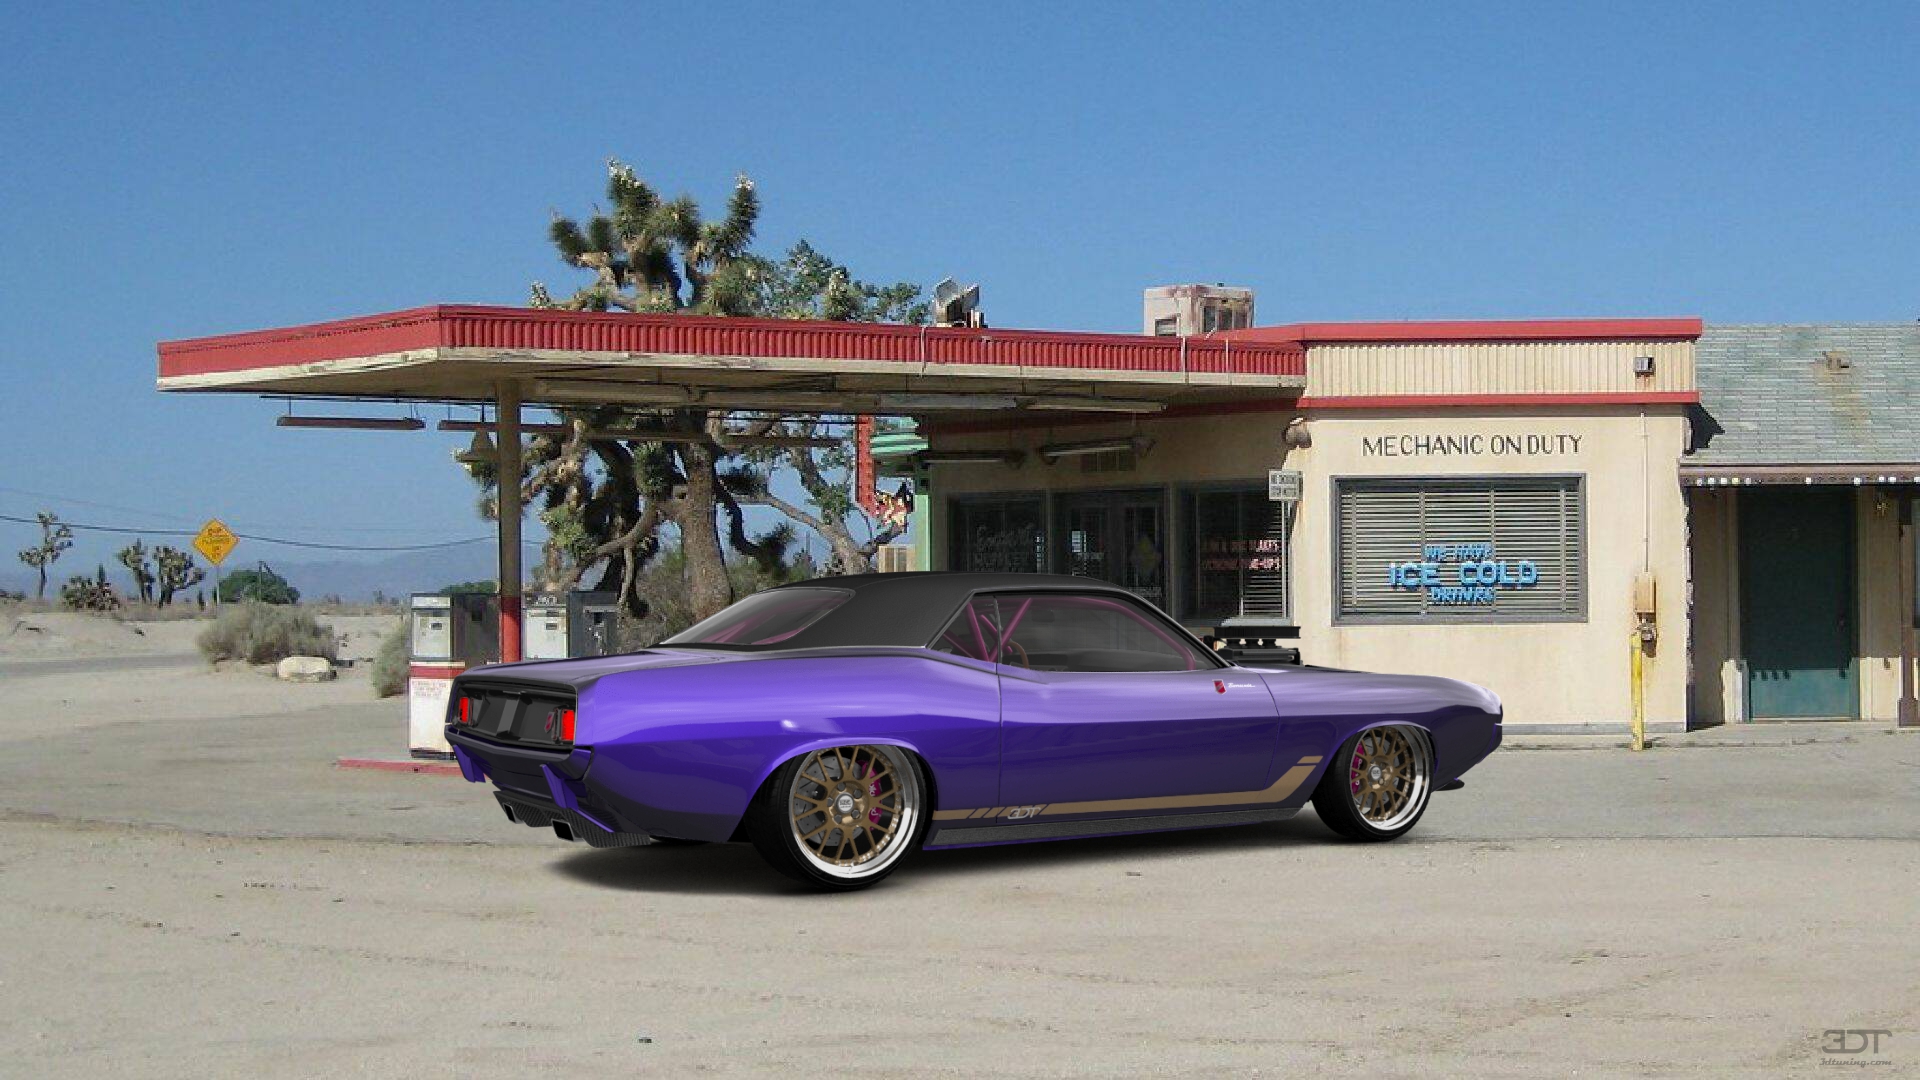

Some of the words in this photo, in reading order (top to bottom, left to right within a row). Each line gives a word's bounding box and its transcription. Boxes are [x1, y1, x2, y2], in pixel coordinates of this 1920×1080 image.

[1363, 435, 1483, 456] MECHANIC
[1491, 435, 1522, 455] ON
[1528, 435, 1582, 455] DUTY
[1389, 563, 1441, 587] ICE
[1459, 561, 1537, 586] COLD
